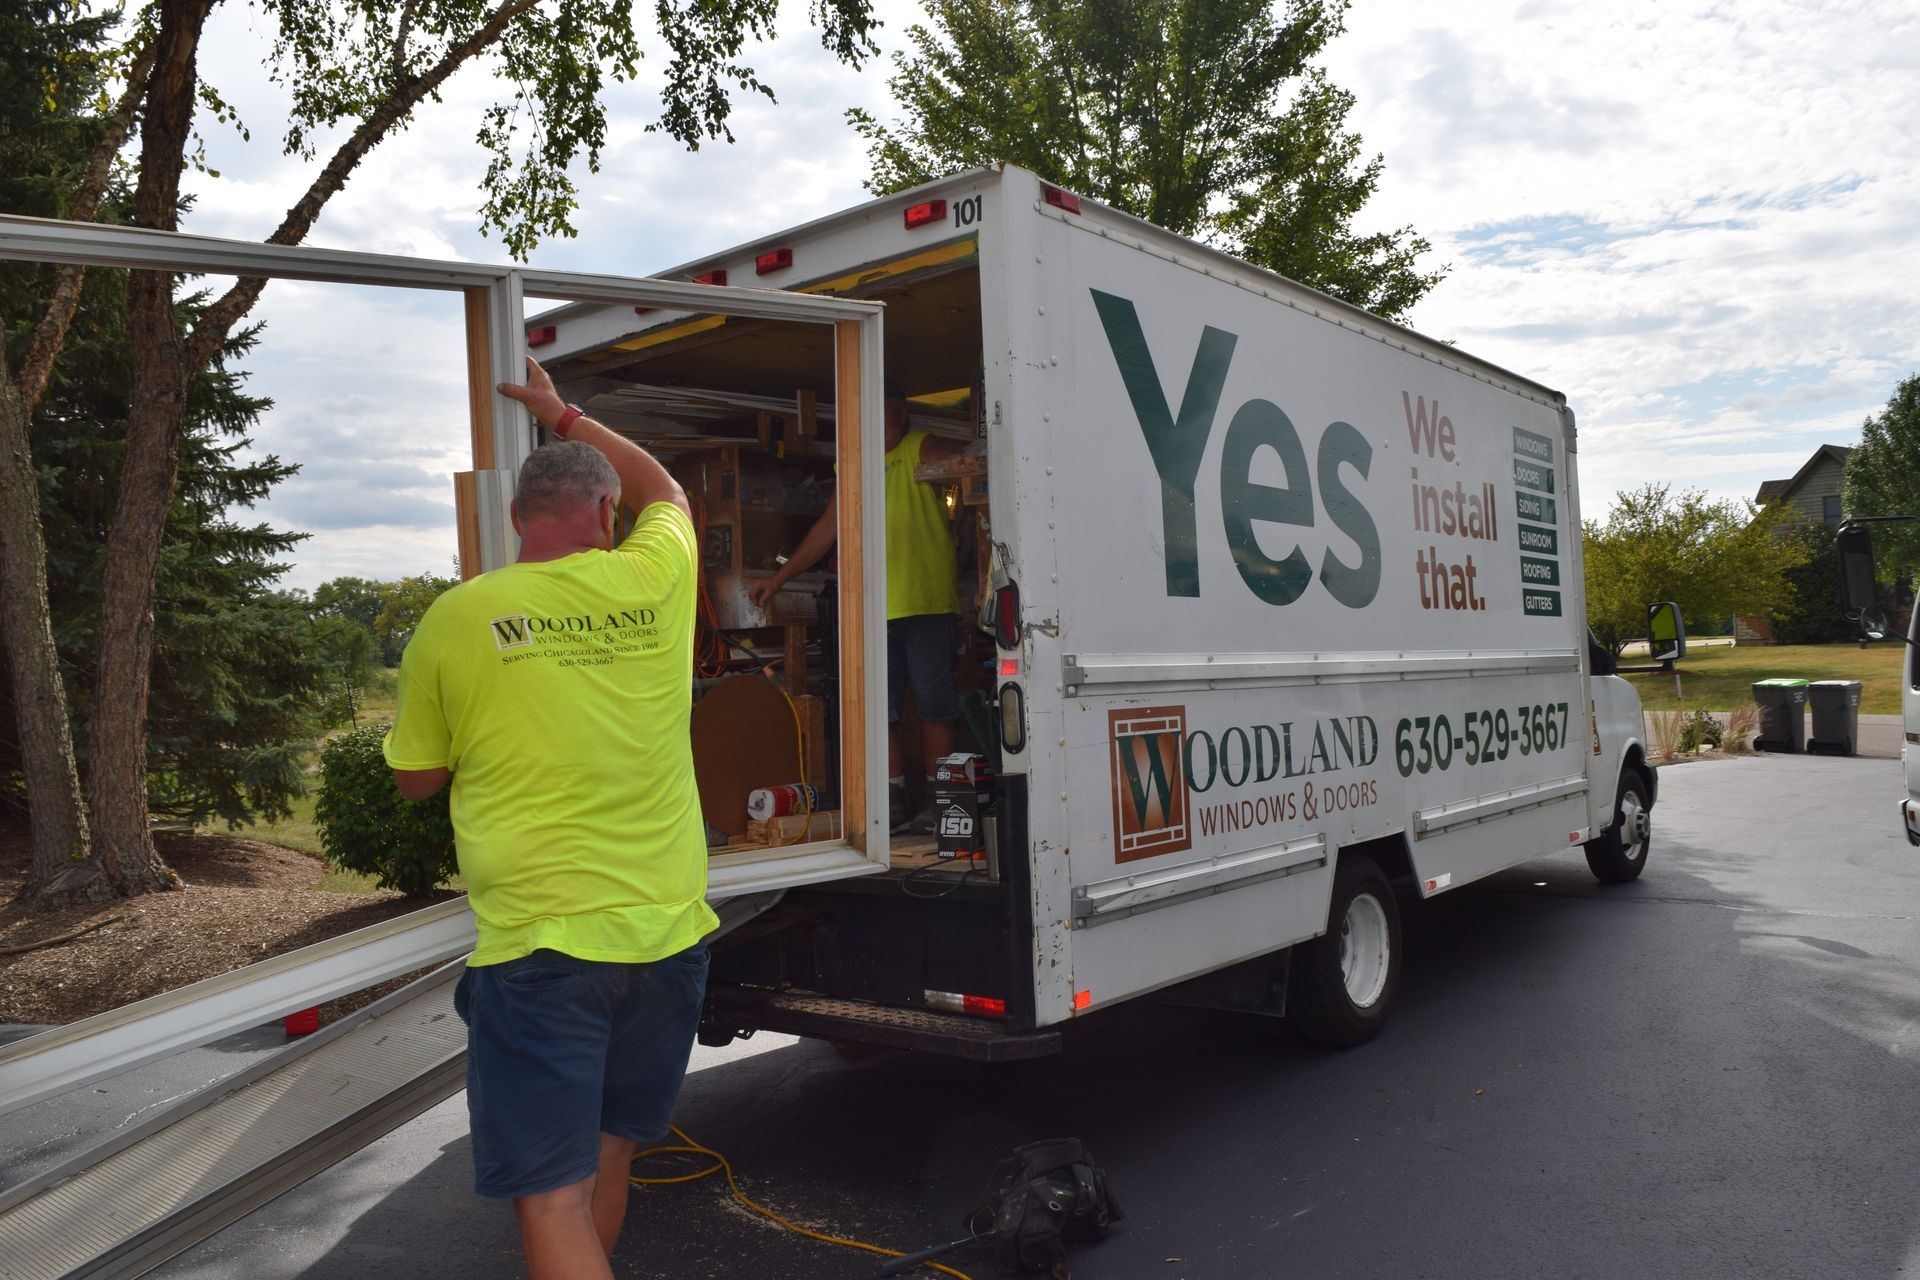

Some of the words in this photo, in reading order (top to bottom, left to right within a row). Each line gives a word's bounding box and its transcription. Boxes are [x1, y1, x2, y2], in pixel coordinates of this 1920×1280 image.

[953, 195, 982, 228] 101
[1402, 390, 1456, 463] We
[1089, 287, 1382, 609] Yes
[1515, 434, 1548, 457] WINDOWS
[1516, 468, 1540, 485] DOORS
[1411, 467, 1498, 541] install
[1518, 499, 1540, 516] SIDING
[1520, 530, 1552, 549] SUNROOM
[1416, 546, 1486, 611] that.
[1523, 562, 1551, 580] ROOFING
[1525, 595, 1553, 611] GUTTERS
[492, 608, 656, 644] WOODLAND
[535, 634, 600, 644] WINDOWS
[604, 633, 615, 645] &
[619, 627, 658, 640] DOORS
[502, 651, 543, 665] SERVING
[543, 648, 613, 658] CHICAGOLAND
[614, 644, 641, 653] SINCE
[641, 641, 659, 651] 1969
[558, 657, 614, 667] 630-529-3667
[1395, 702, 1569, 777] 630-529-3667
[1115, 715, 1378, 833] WOODLAND
[1199, 793, 1296, 837] WINDOWS
[1302, 781, 1319, 822] &
[1323, 780, 1378, 814] DOORS
